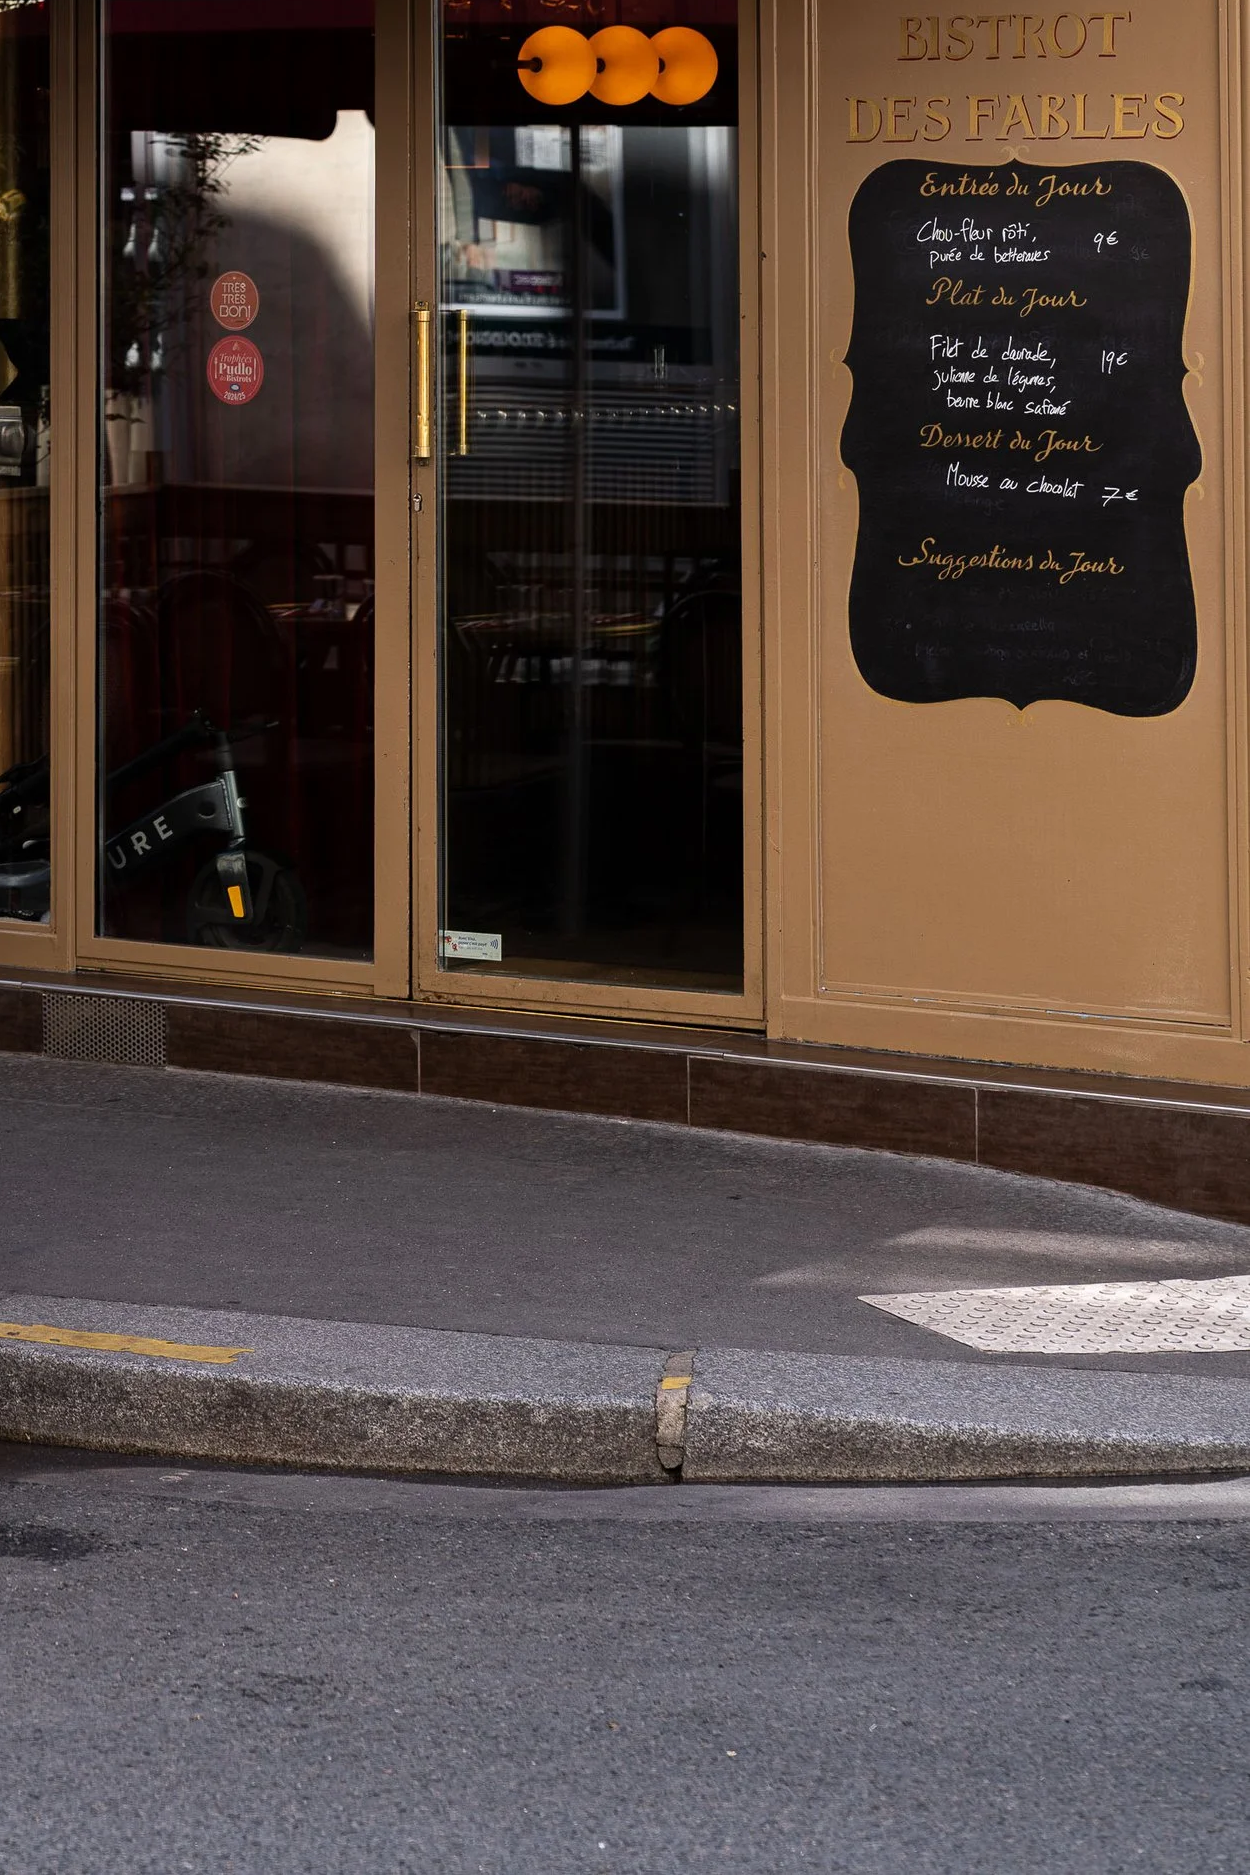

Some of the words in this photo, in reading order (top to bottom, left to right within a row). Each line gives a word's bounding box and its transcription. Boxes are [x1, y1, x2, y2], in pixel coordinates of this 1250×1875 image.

[897, 11, 1132, 61] BISTROT
[845, 94, 952, 143] DES
[965, 92, 1185, 141] FABLES
[919, 172, 999, 196] Entrée
[1006, 172, 1030, 196] du
[1035, 175, 1112, 207] Jour
[916, 216, 994, 243] Chou-fleur
[929, 247, 962, 269] purée
[969, 244, 986, 262] de
[925, 276, 986, 306] Plat
[991, 286, 1018, 306] du
[1019, 287, 1088, 317] Jour
[929, 334, 965, 361] Filet
[971, 335, 989, 359] de
[219, 362, 253, 375] Pudlo
[983, 365, 1000, 383] de
[986, 390, 1015, 411] blanc
[919, 422, 1004, 449] Dessert
[1008, 430, 1032, 450] du
[1034, 429, 1103, 462] Jour
[946, 461, 990, 489] Mousse
[999, 477, 1018, 490] au
[1026, 475, 1086, 499] chocolat
[898, 537, 1034, 580] Suggestions
[1039, 549, 1065, 571] du
[1059, 552, 1125, 584] Jour
